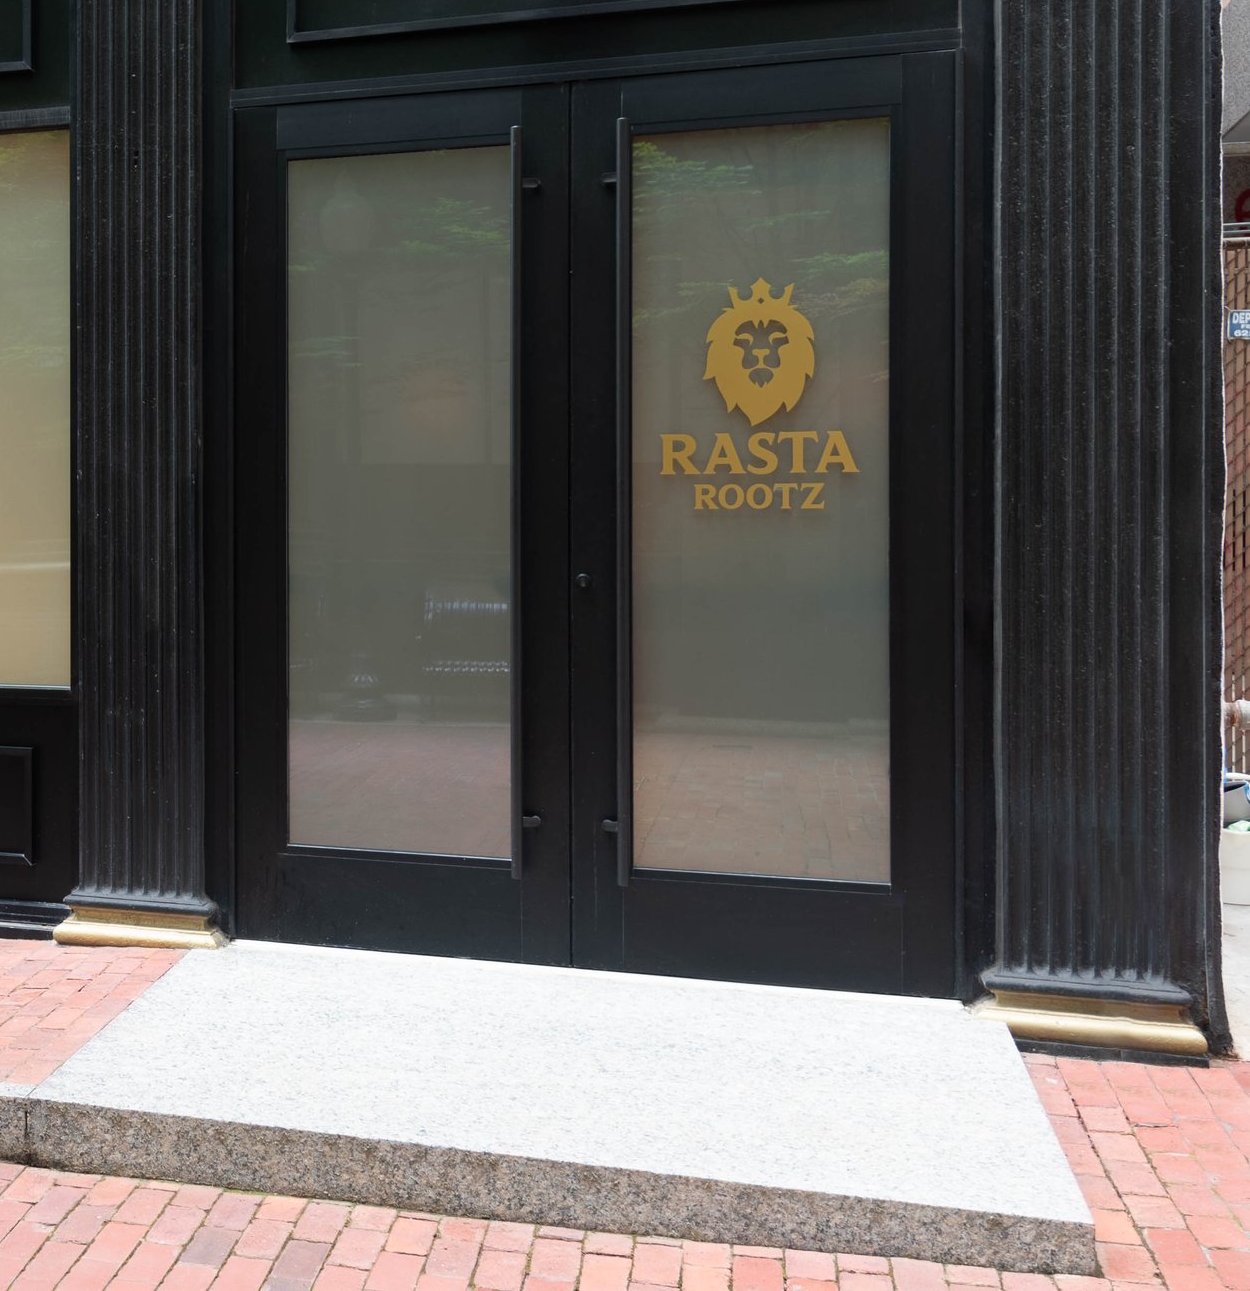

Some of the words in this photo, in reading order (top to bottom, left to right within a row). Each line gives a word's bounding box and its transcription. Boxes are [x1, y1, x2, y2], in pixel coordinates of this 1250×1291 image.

[1233, 329, 1250, 337] 62
[660, 430, 860, 475] RASTA
[693, 481, 826, 510] ROOTZ
